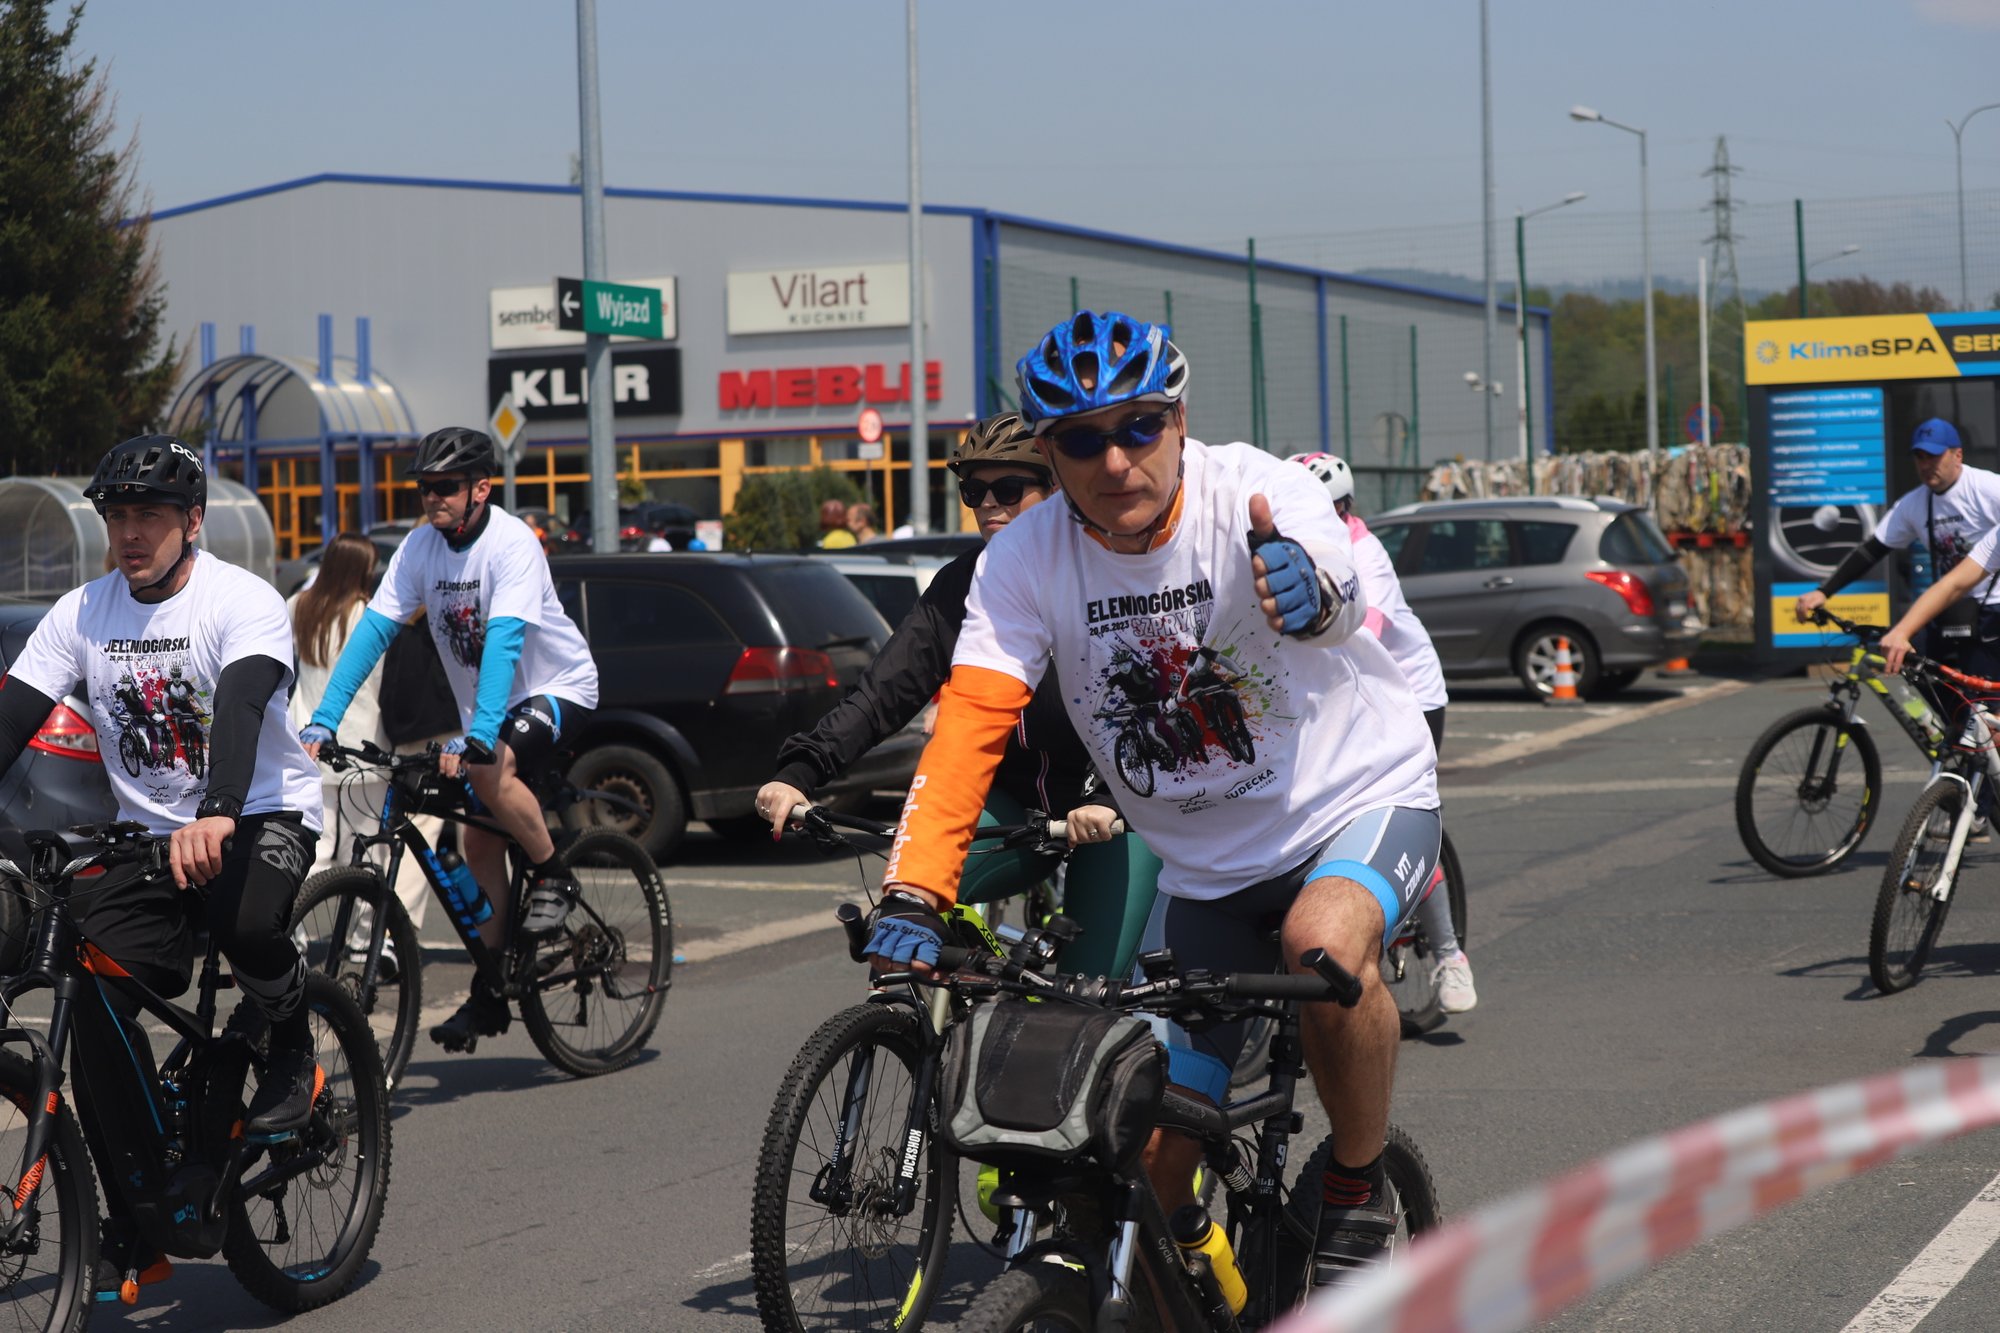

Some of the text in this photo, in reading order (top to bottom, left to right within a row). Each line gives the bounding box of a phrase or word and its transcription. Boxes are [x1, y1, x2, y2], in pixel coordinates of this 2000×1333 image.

[771, 272, 868, 310] Vilart
[597, 291, 650, 328] Wyjazd
[789, 310, 867, 325] KUCHNIE
[1789, 337, 1937, 361] KlimaSPA
[511, 364, 650, 407] KLR
[1089, 619, 1130, 636] 20.05.2023
[1393, 851, 1412, 882] VTT
[877, 921, 898, 932] GEL
[900, 1128, 923, 1179] ROCKSHOX
[1157, 1236, 1175, 1265] Cycle
